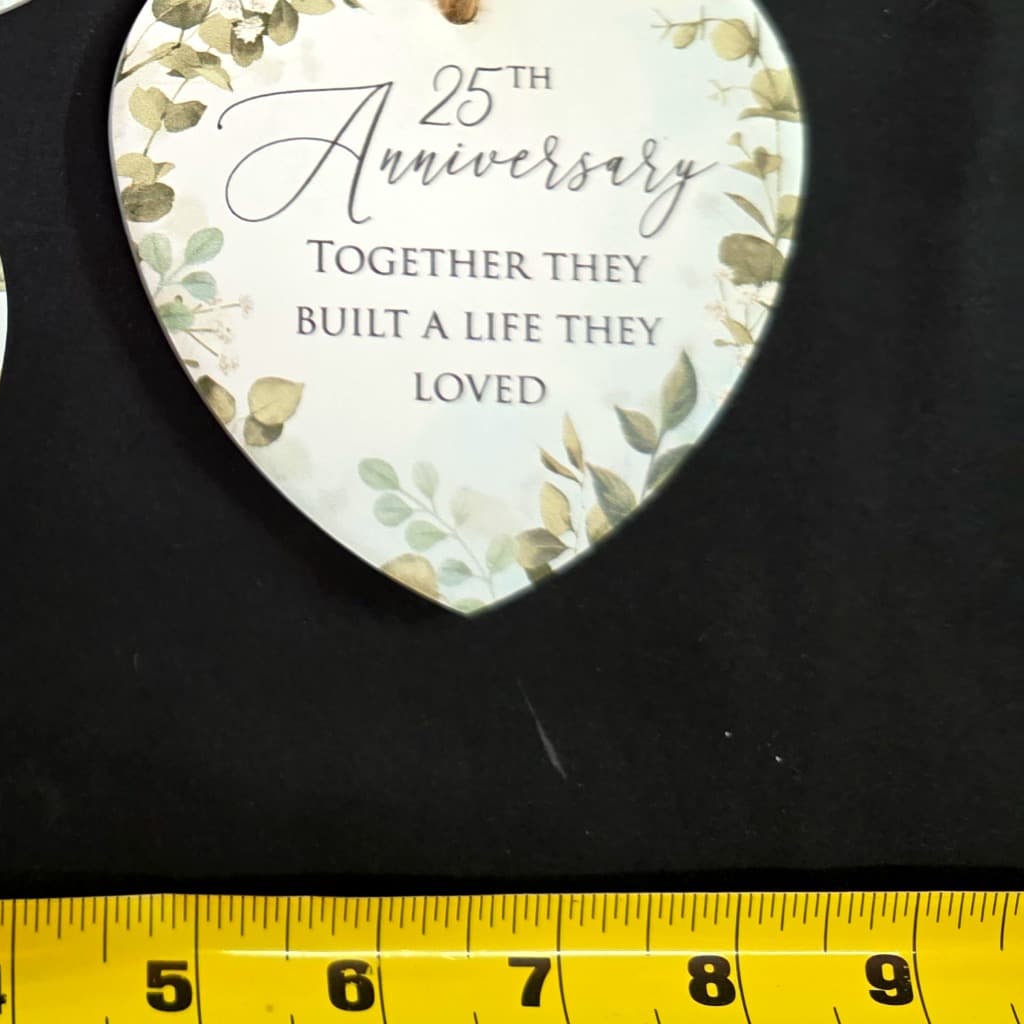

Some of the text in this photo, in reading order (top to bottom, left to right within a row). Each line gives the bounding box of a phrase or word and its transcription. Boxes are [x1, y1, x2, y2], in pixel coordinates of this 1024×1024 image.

[216, 81, 719, 238] Anniversary
[306, 239, 648, 283] TOGETHER THEY
[296, 306, 663, 347] BUILT A LIFE THEY
[414, 372, 547, 405] LOVED
[145, 959, 193, 1012] 5
[326, 959, 376, 1012] 6
[508, 957, 552, 1008] 7
[687, 954, 736, 1007] 8
[865, 953, 914, 1006] 9
